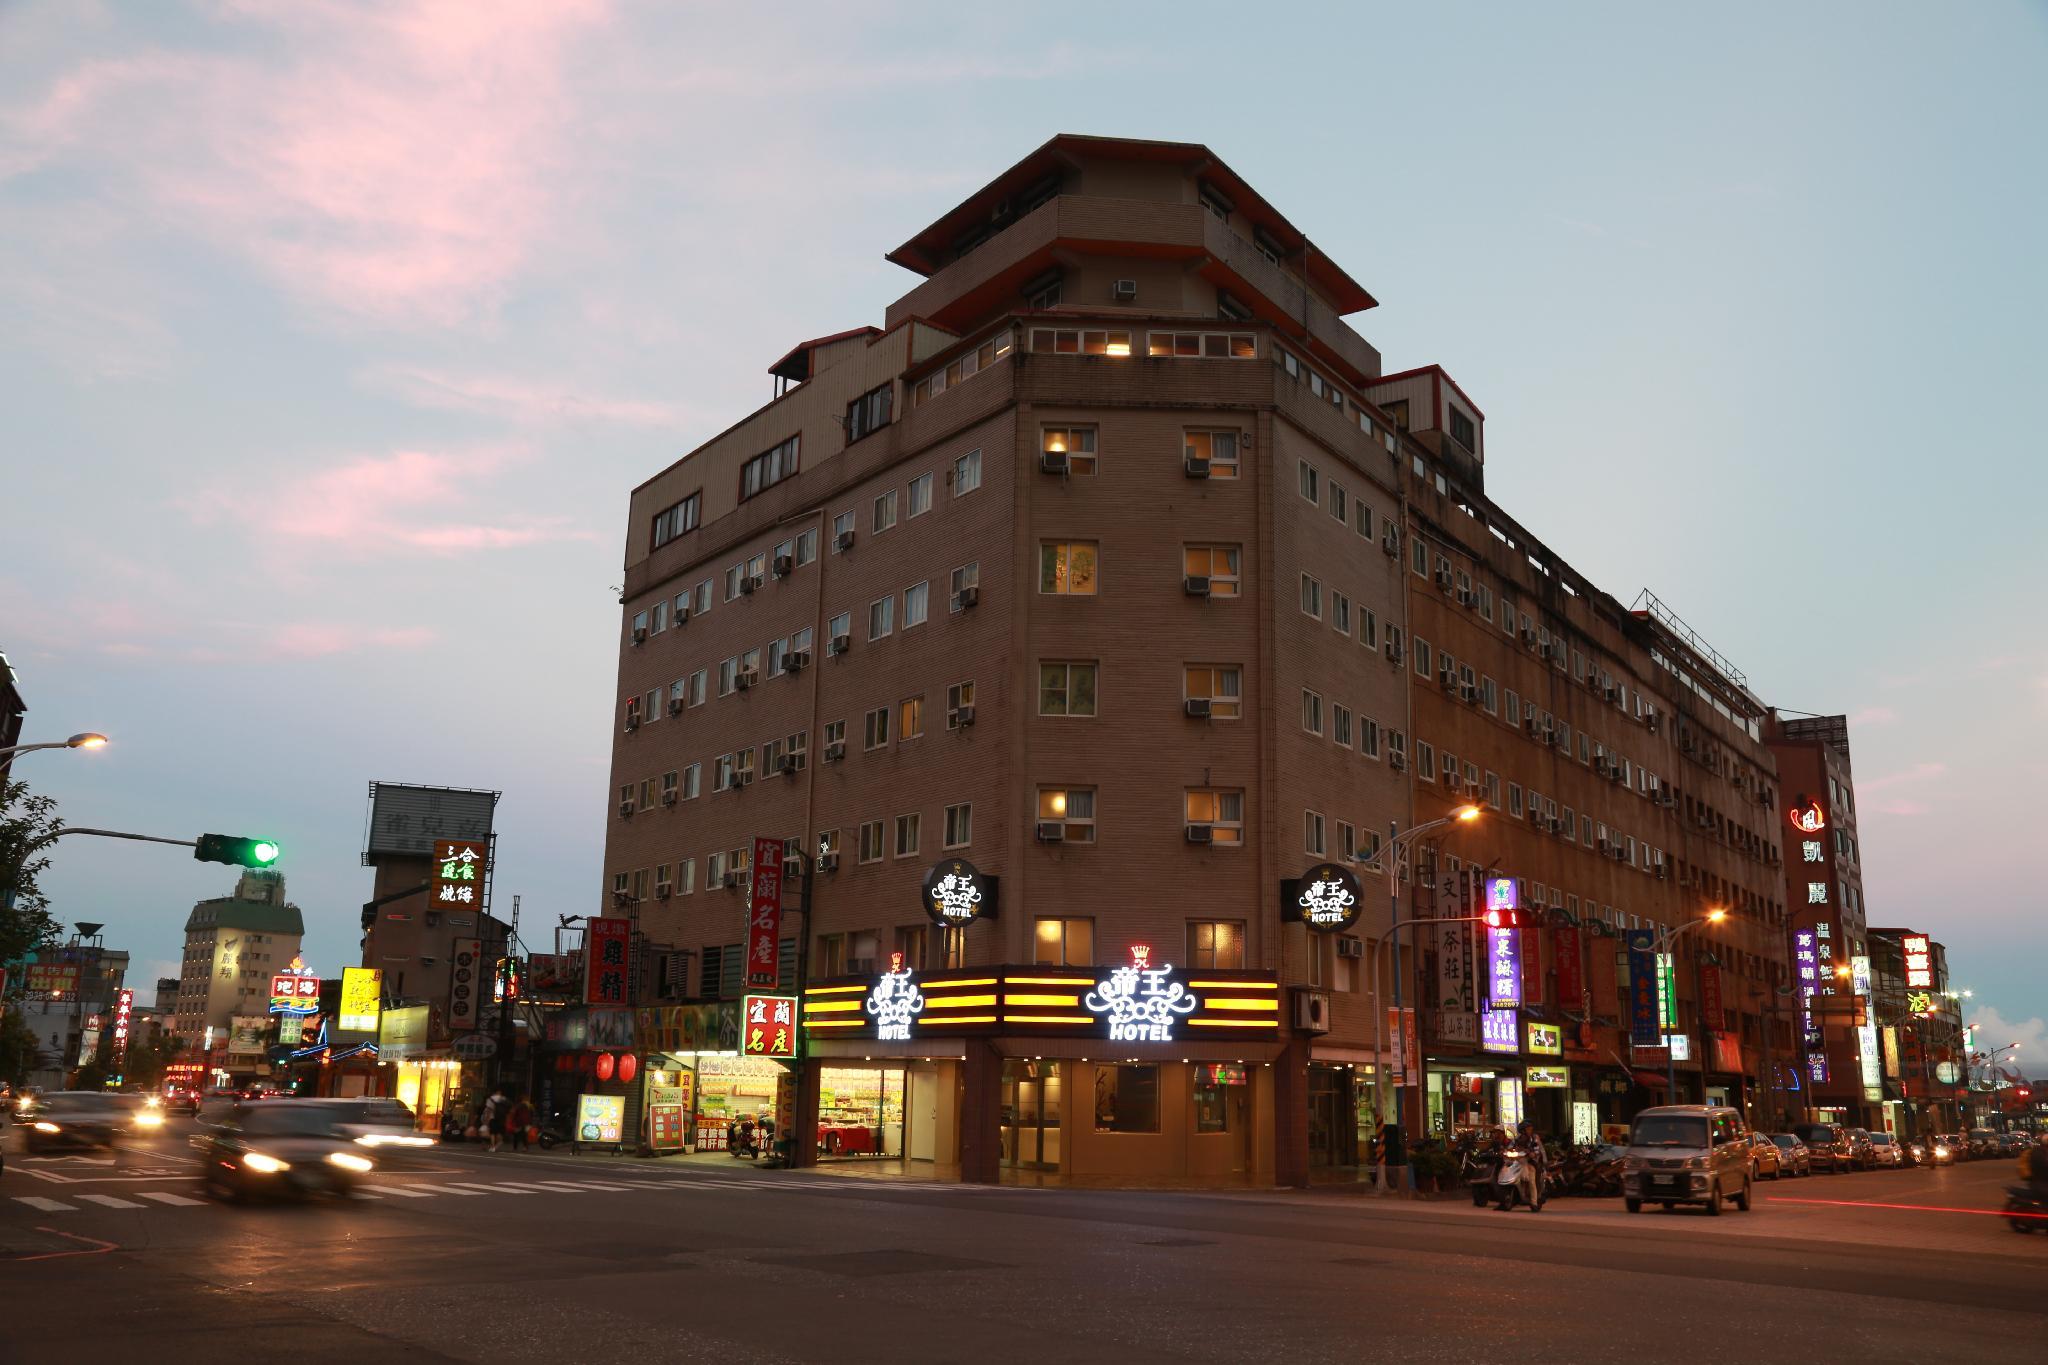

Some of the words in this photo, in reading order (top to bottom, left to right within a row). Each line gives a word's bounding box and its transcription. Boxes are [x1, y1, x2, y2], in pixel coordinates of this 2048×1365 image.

[440, 845, 480, 862] 三合
[751, 841, 779, 964] 宜蘭名產
[942, 905, 971, 918] HOTEL
[1310, 913, 1344, 923] HOTEL
[1443, 878, 1460, 980] 文山茶莊
[750, 999, 790, 1025] 宜蘭
[719, 1007, 738, 1047] 茶
[878, 1025, 911, 1040] HOTEL
[1109, 1024, 1173, 1041] HOTEL
[747, 1028, 789, 1053] 名產
